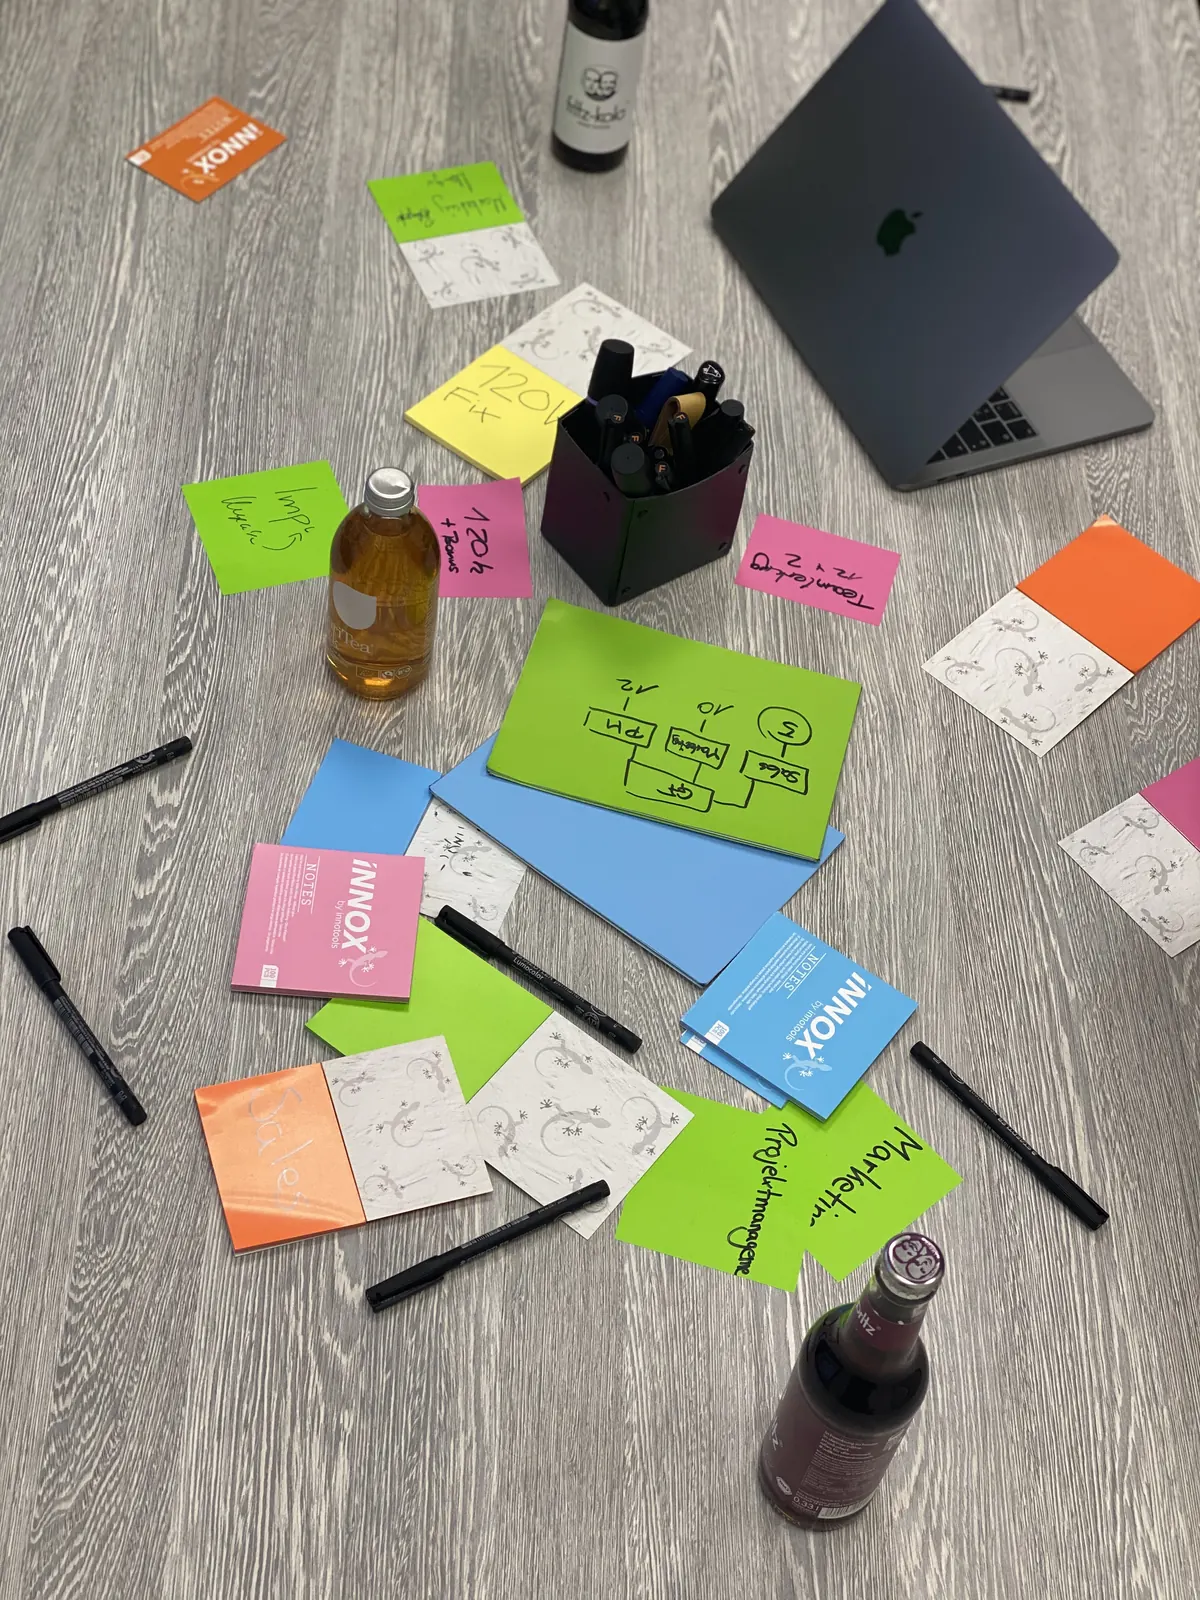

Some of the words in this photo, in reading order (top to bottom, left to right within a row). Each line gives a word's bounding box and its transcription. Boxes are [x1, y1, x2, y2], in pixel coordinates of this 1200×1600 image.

[443, 386, 502, 424] Fix
[785, 553, 802, 568] 2
[616, 678, 660, 694] 12
[696, 702, 735, 717] 10
[606, 718, 645, 740] PM
[301, 862, 318, 906] NOTES
[334, 900, 346, 912] by
[331, 912, 342, 950] innotools
[512, 956, 546, 982] Lumocolor
[786, 954, 820, 992] NOTES
[811, 1000, 824, 1011] by
[786, 1010, 814, 1042] innotools
[248, 1086, 314, 1212] Sales
